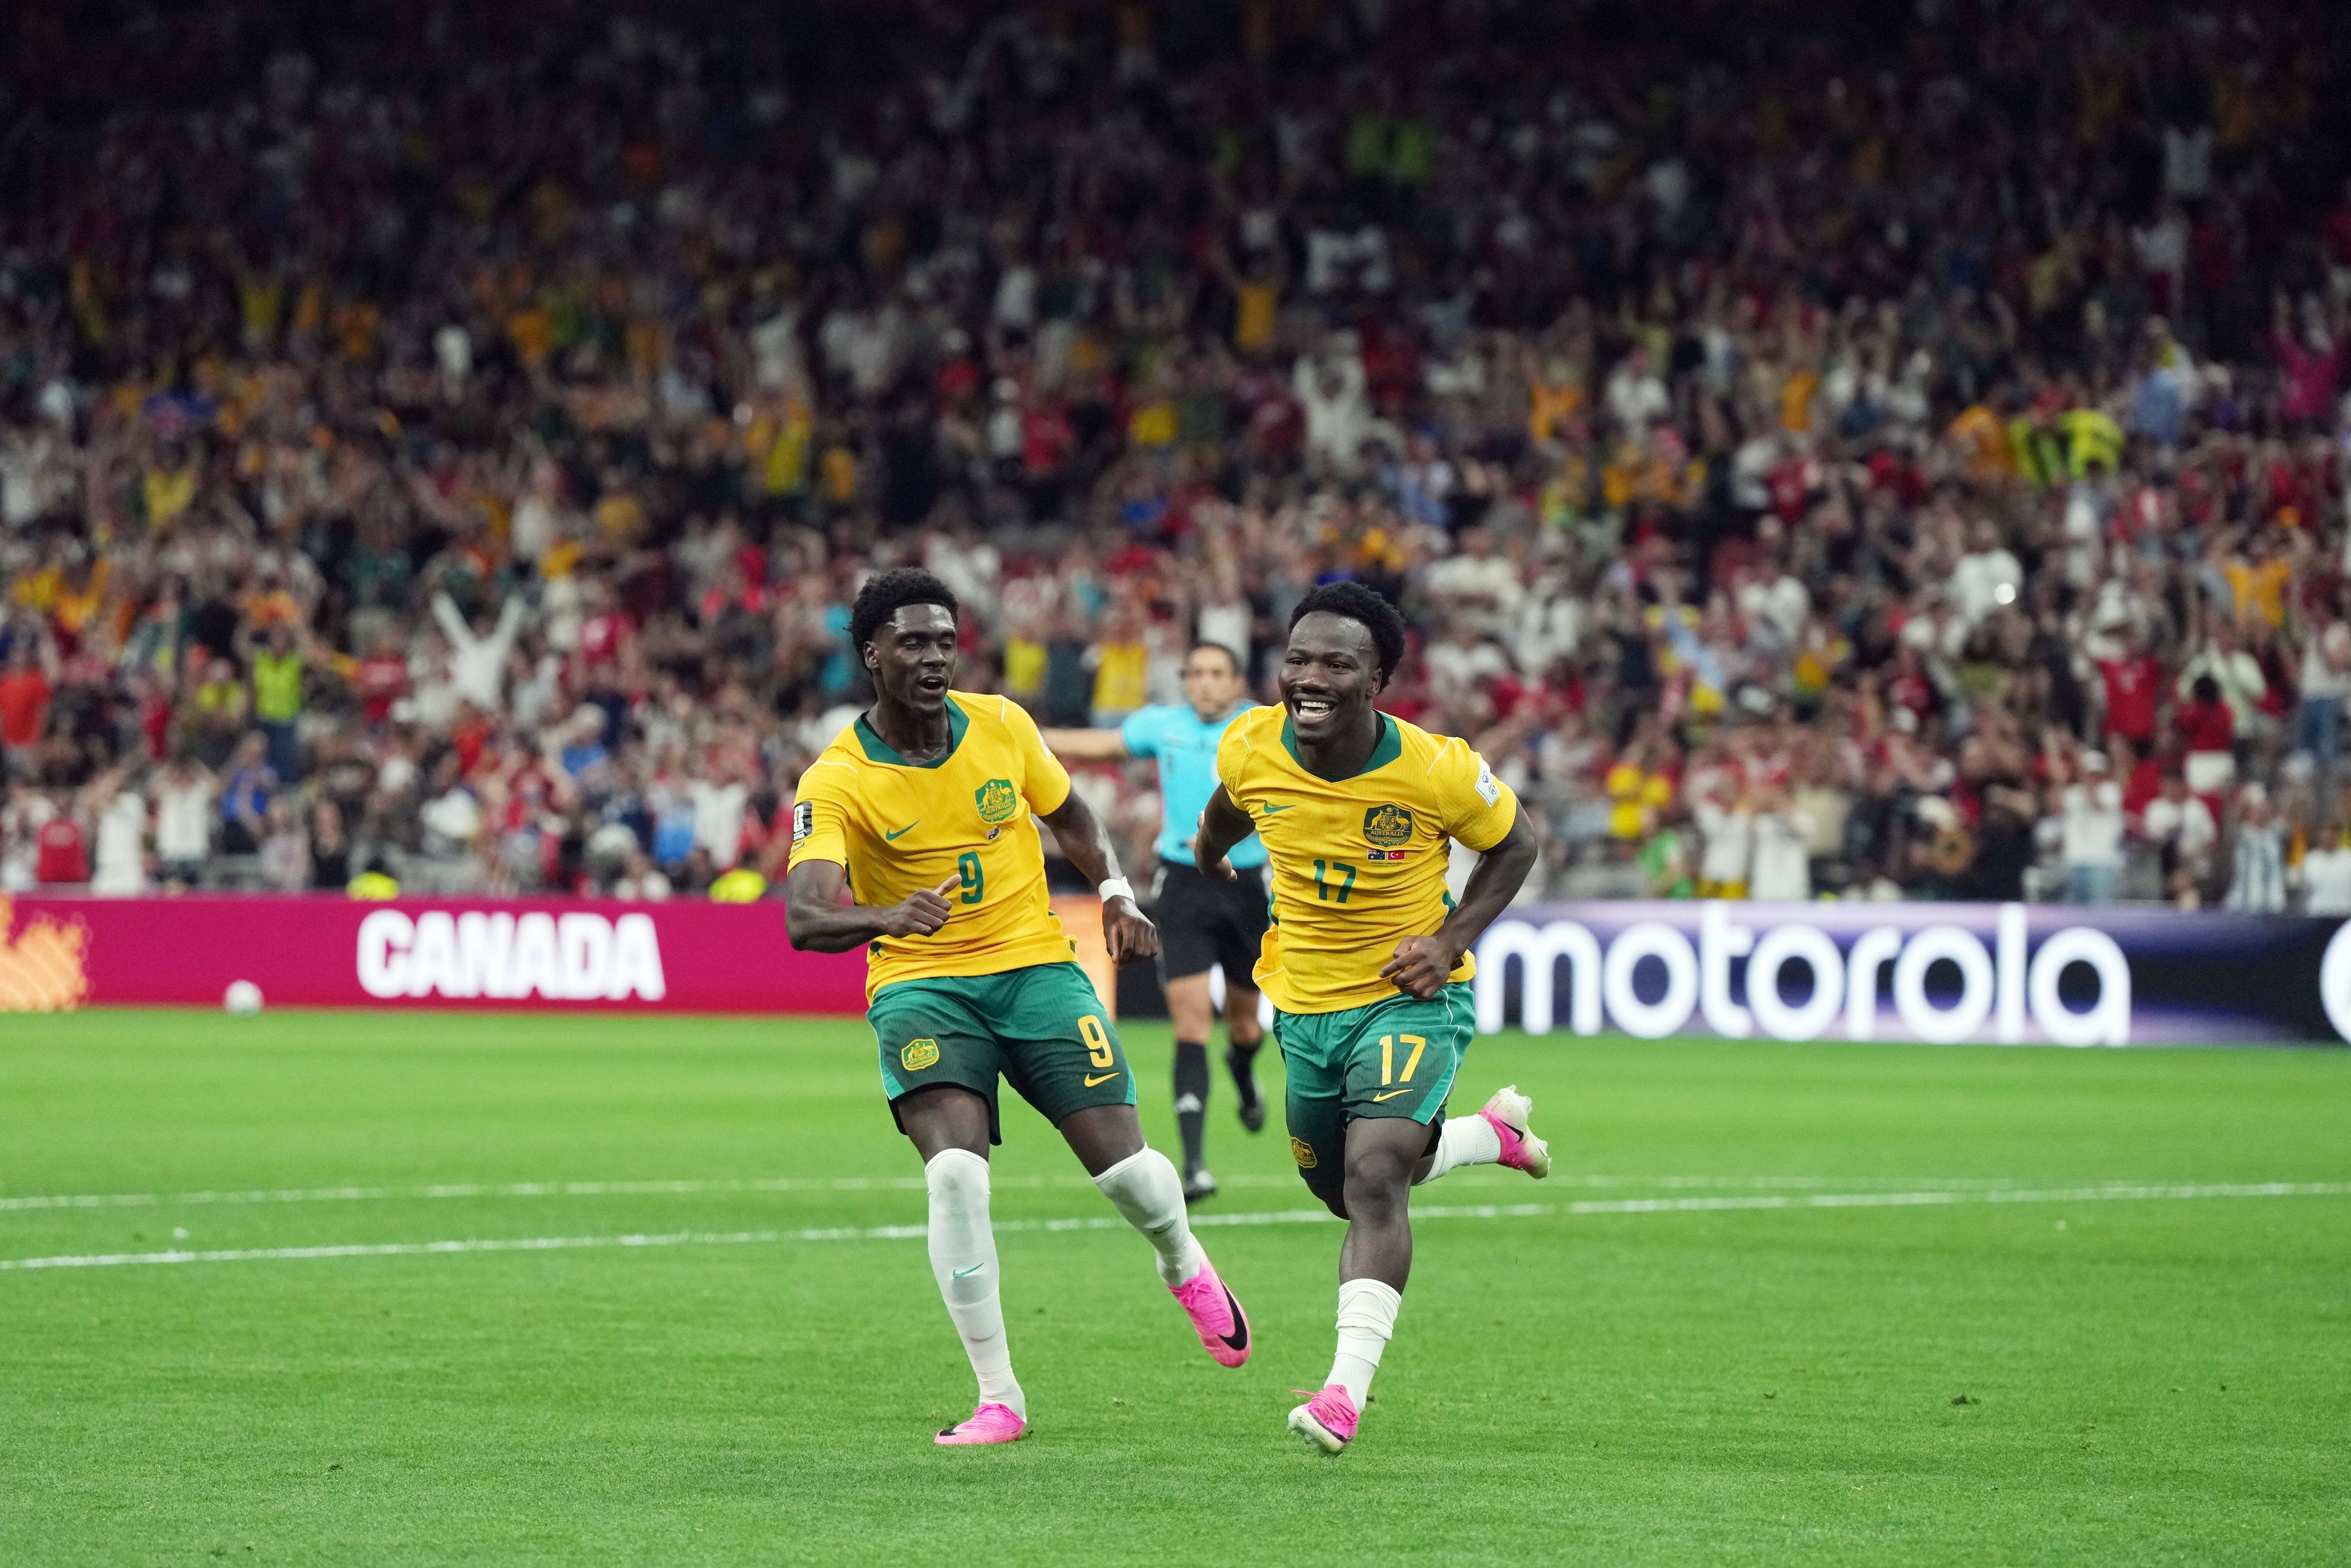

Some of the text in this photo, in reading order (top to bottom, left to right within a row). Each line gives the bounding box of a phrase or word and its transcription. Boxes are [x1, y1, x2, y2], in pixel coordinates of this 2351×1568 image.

[986, 802, 1011, 814] AUSTRALIA
[957, 851, 983, 904] 9
[1313, 859, 1356, 903] 17
[357, 909, 665, 1000] CANADA
[1476, 900, 2131, 1047] motorola
[1077, 1014, 1114, 1067] 9
[1379, 1034, 1426, 1086] 17
